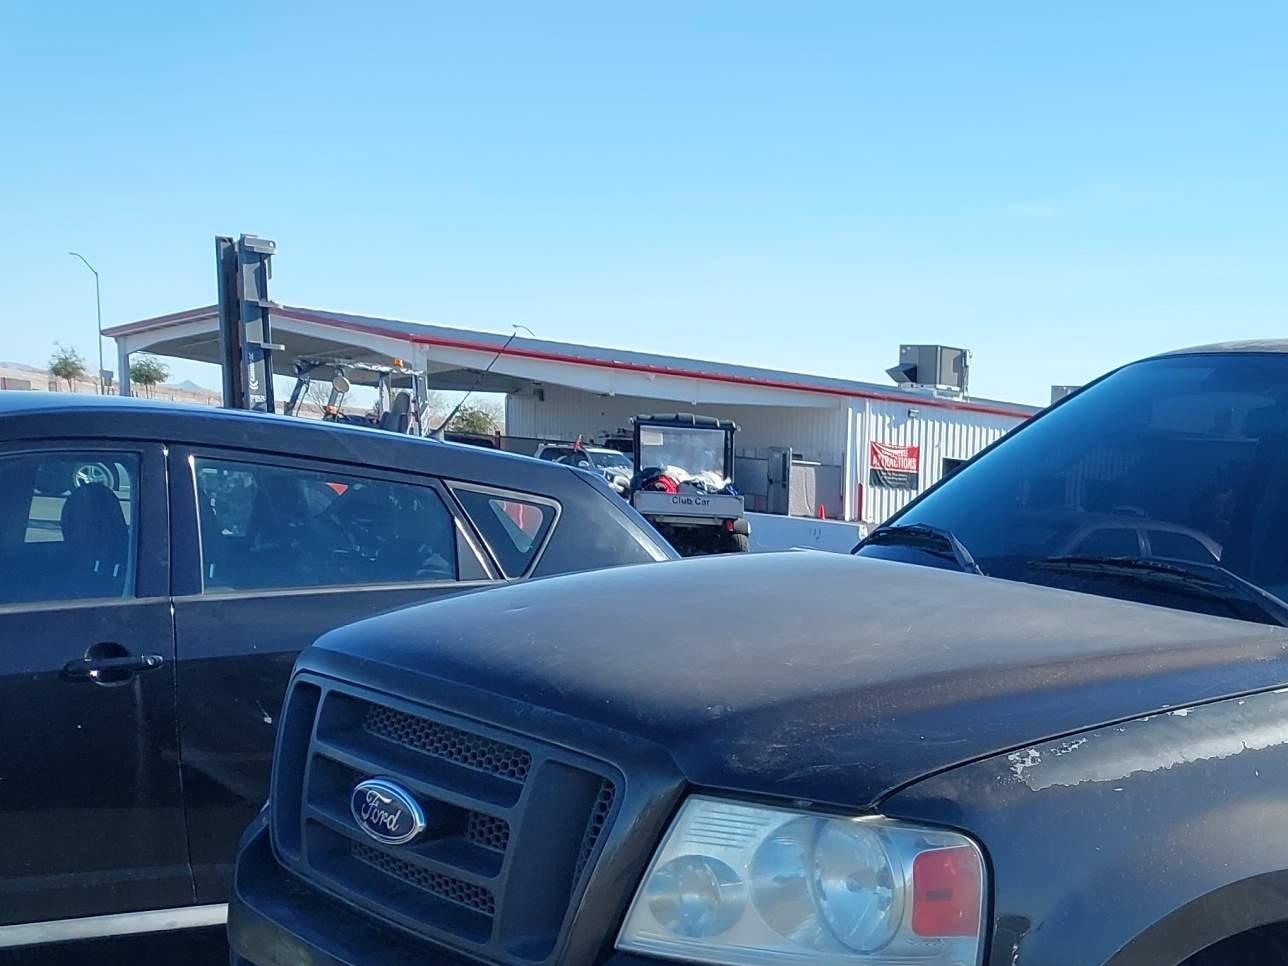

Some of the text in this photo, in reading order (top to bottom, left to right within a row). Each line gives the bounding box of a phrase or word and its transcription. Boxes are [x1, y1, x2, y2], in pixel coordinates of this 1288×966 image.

[671, 496, 711, 506] Club Car
[361, 790, 402, 832] Ford
